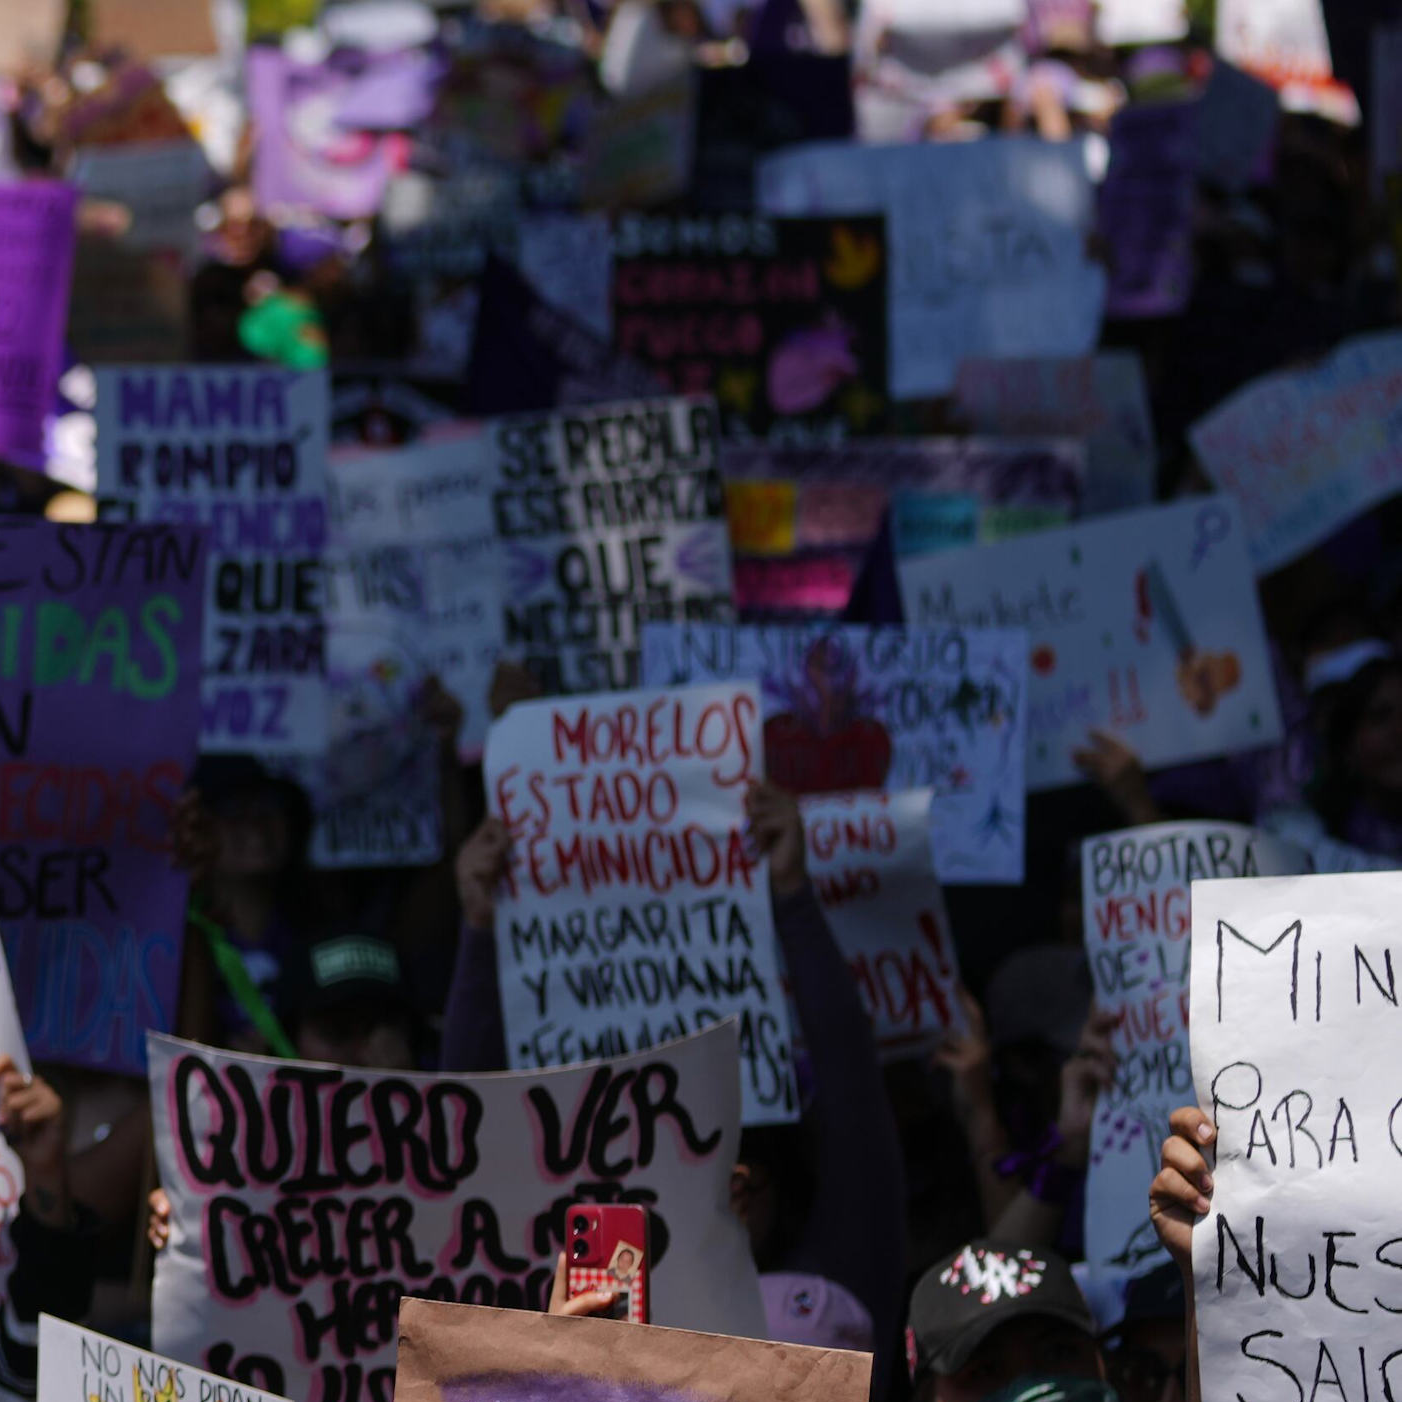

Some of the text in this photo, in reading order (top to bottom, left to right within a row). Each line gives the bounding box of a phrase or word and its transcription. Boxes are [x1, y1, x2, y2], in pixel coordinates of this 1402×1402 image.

[551, 692, 757, 786] MORELOS
[498, 768, 678, 829] ESTADO
[509, 897, 754, 966] MARGARITA
[1095, 889, 1191, 943] VENG
[1096, 944, 1144, 997] DE
[172, 1051, 722, 1193] QUIERO VER
[1211, 1061, 1360, 1169] PARA
[205, 1196, 433, 1299] CRECER
[80, 1335, 122, 1379] NO
[136, 1356, 186, 1400] NOS
